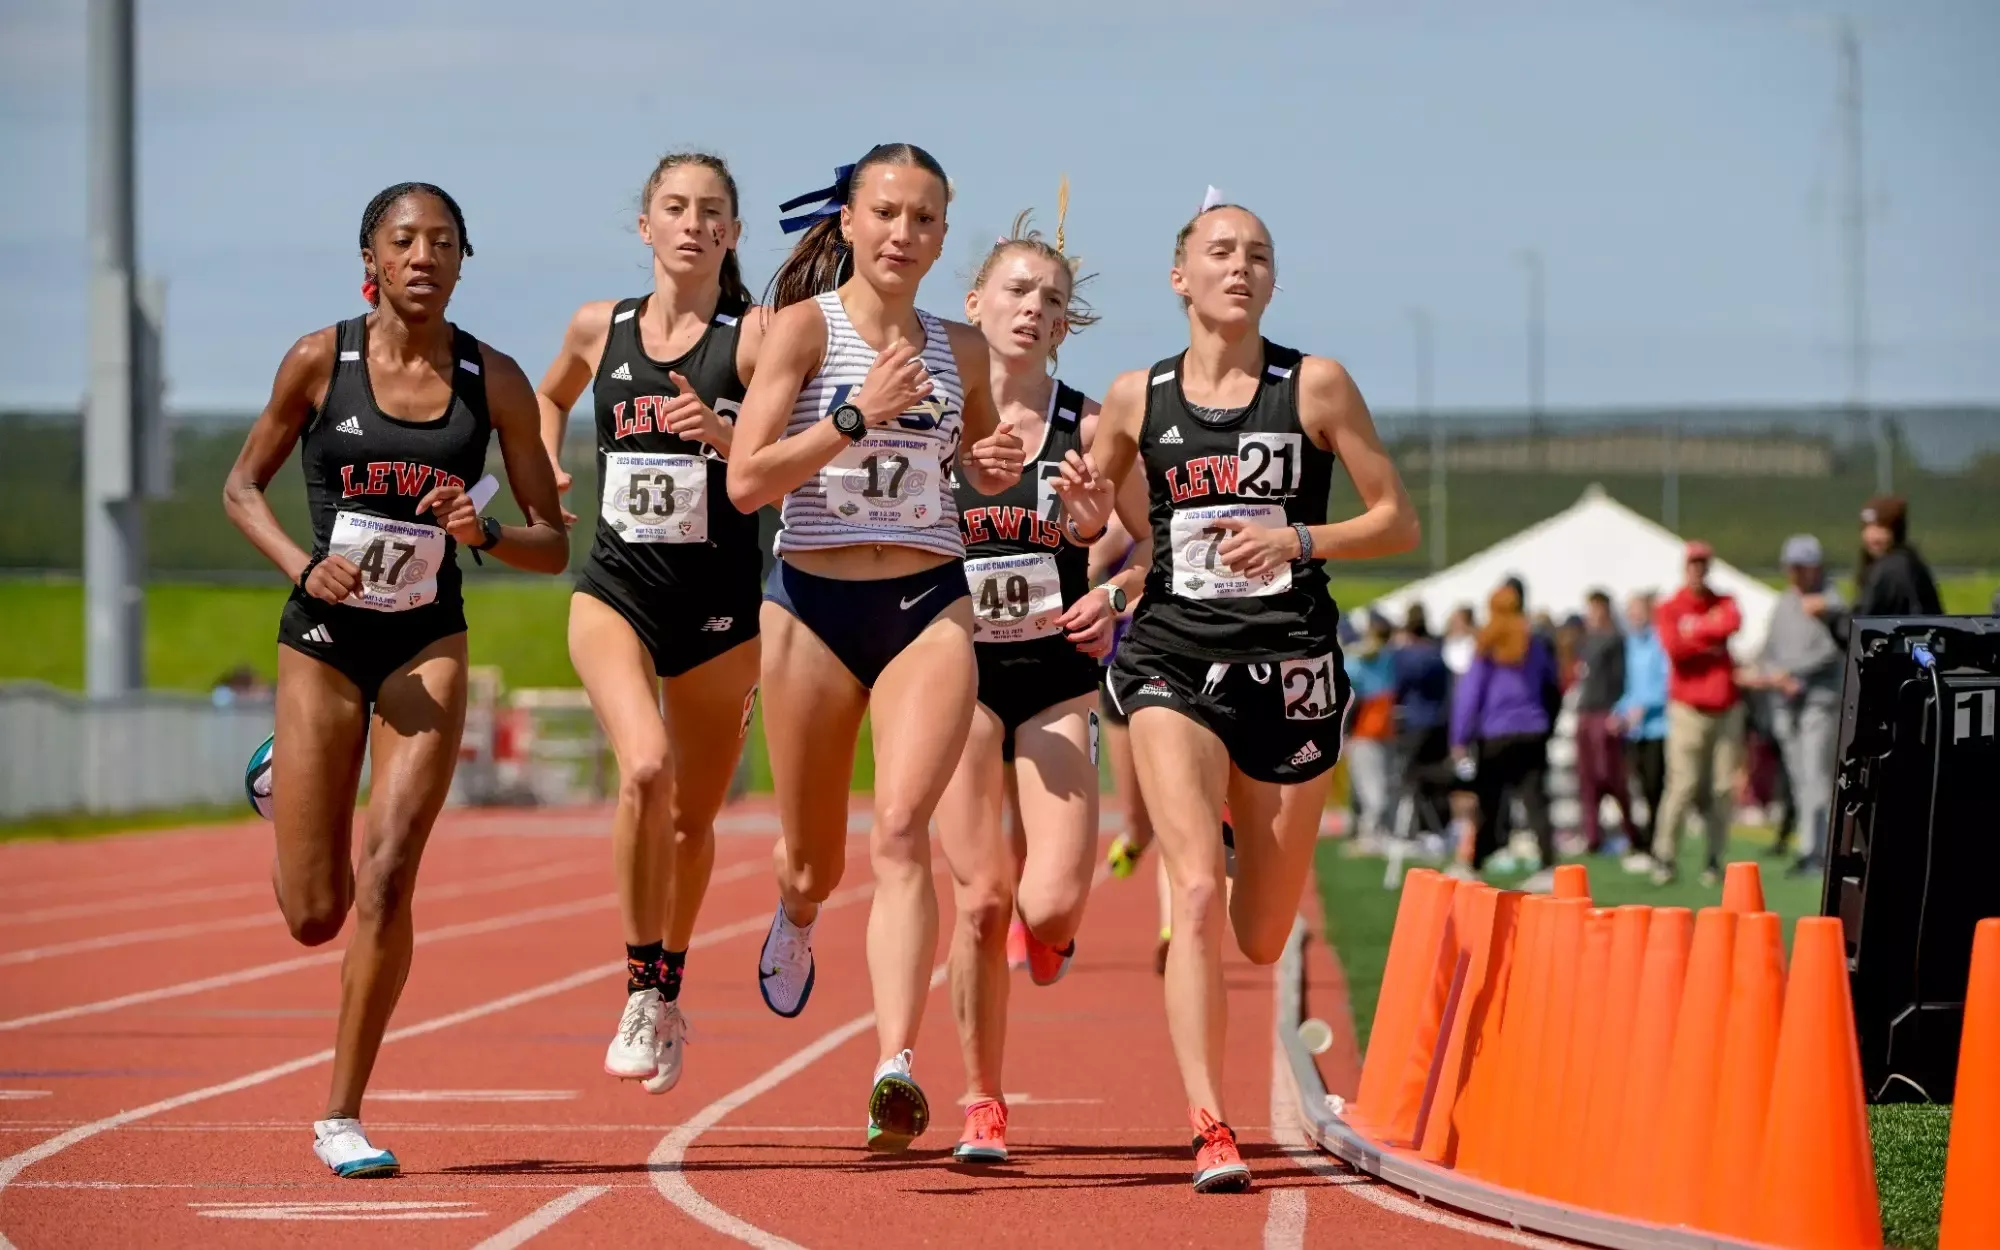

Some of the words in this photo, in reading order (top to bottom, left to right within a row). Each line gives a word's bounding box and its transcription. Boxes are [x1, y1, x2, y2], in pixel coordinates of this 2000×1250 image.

[336, 425, 363, 435] adidas
[613, 396, 677, 440] LEW
[617, 457, 629, 465] 2025
[645, 458, 693, 467] CHAMPIONSHIPS
[862, 456, 909, 498] 17
[1165, 455, 1239, 503] LEW
[1238, 442, 1295, 497] 21
[629, 474, 675, 516] 53
[359, 538, 416, 585] 47
[992, 557, 1044, 570] CHAMPIONSHIPS
[979, 575, 1030, 619] 49
[1284, 660, 1336, 718] 21
[1291, 750, 1322, 765] adidas
